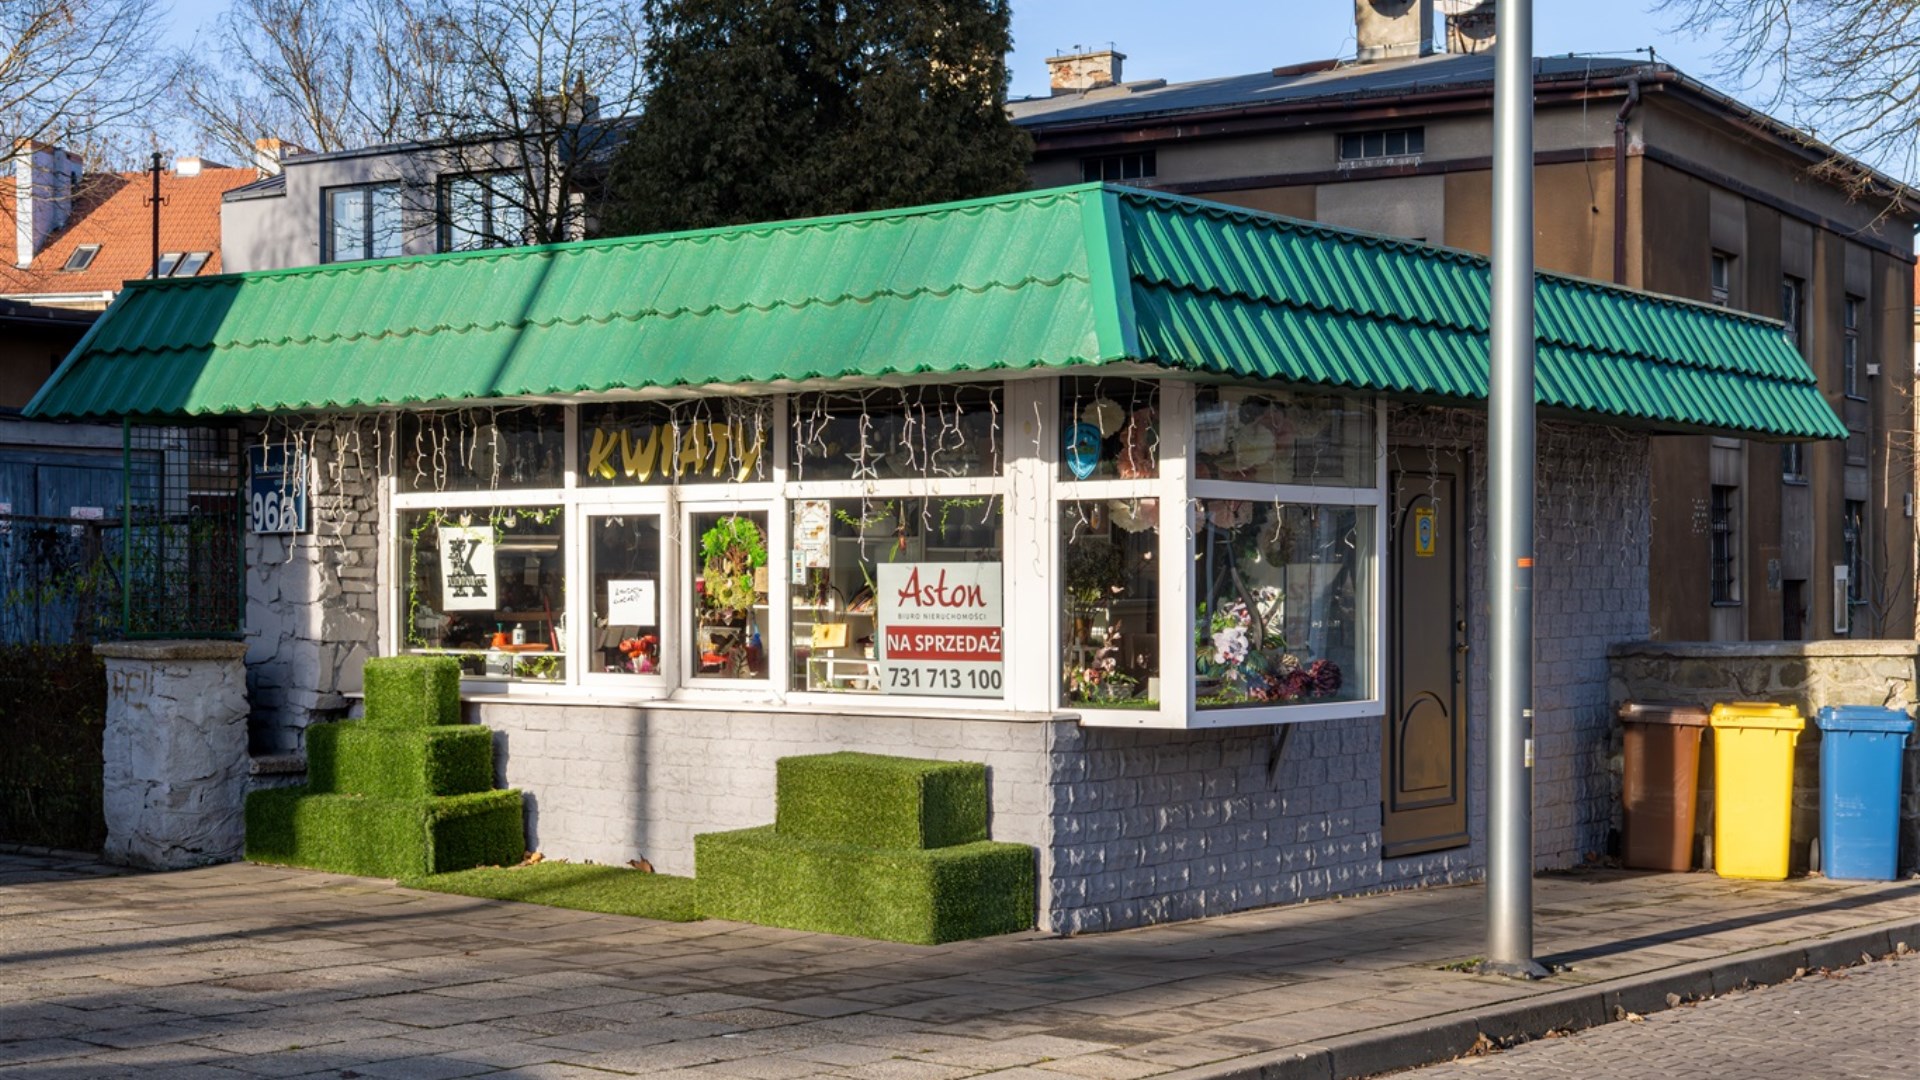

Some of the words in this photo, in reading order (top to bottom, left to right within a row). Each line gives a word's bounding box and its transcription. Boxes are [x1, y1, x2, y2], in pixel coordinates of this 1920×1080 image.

[588, 423, 766, 482] KWIATY
[253, 491, 299, 531] 96a
[898, 566, 987, 608] Aston
[923, 612, 987, 620] NIERUCHOMOŚCI
[887, 634, 911, 651] NA
[915, 631, 1000, 653] SPRZEDAŻ
[888, 667, 920, 687] 731
[926, 668, 961, 688] 713
[967, 669, 1002, 690] 100
